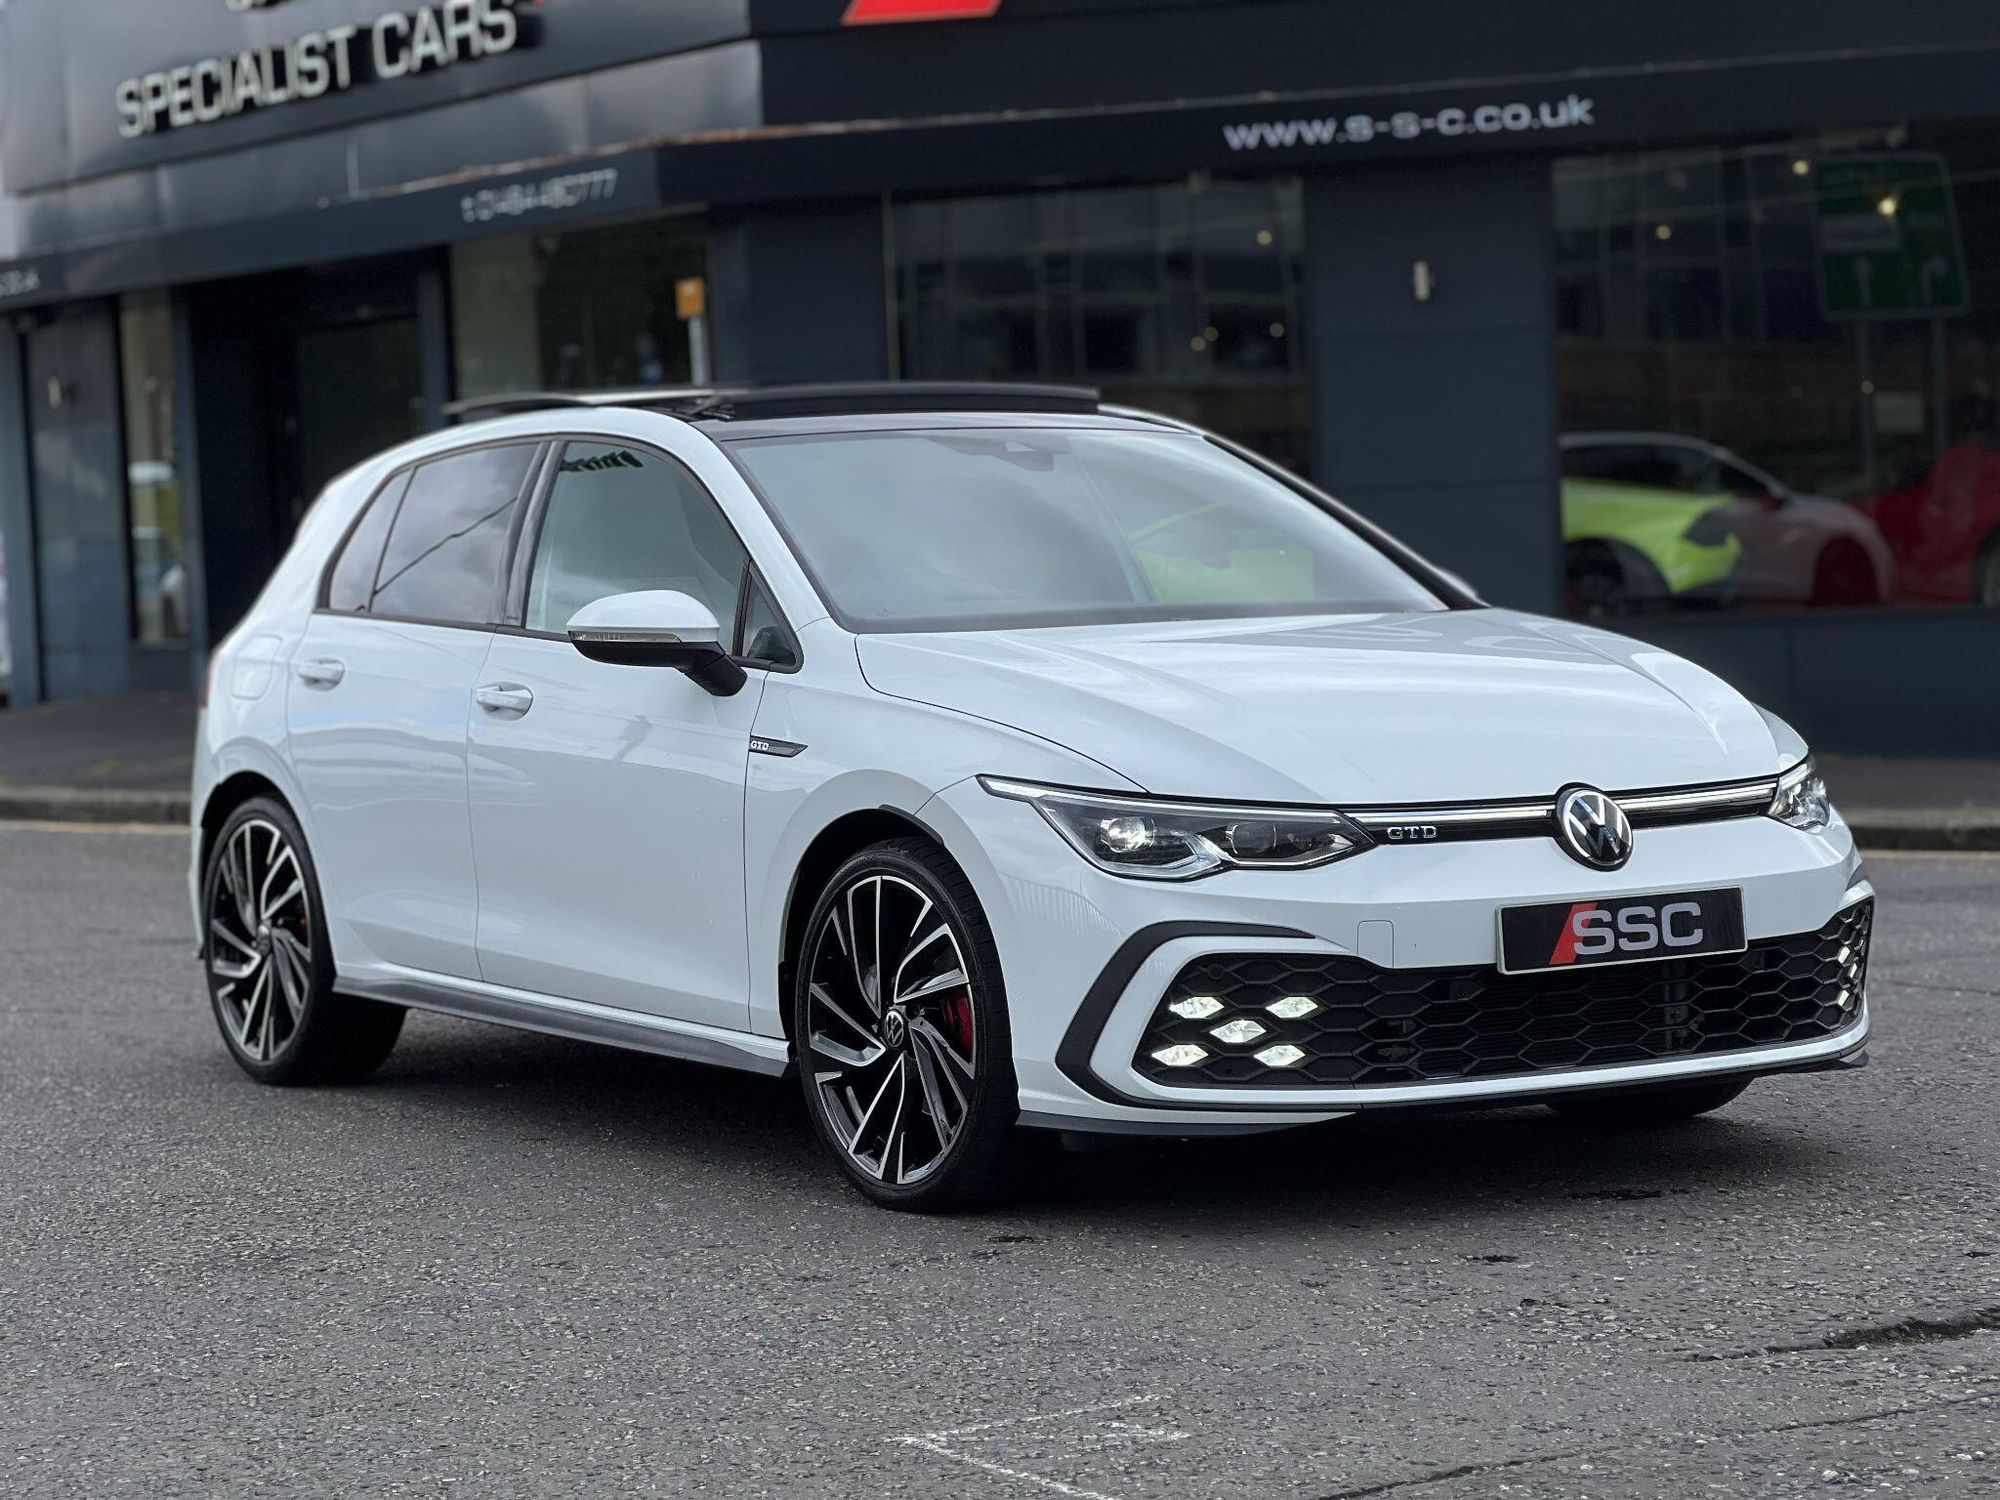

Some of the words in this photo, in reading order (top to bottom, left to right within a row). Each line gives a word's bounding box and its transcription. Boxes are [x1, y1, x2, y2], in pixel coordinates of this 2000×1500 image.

[116, 24, 357, 138] SPECIALIST
[371, 0, 517, 79] CARS
[1223, 93, 1595, 151] www.s-s-c.co.uk
[750, 740, 770, 751] GTD
[1386, 825, 1438, 840] GTD
[1572, 902, 1704, 955] SSC
